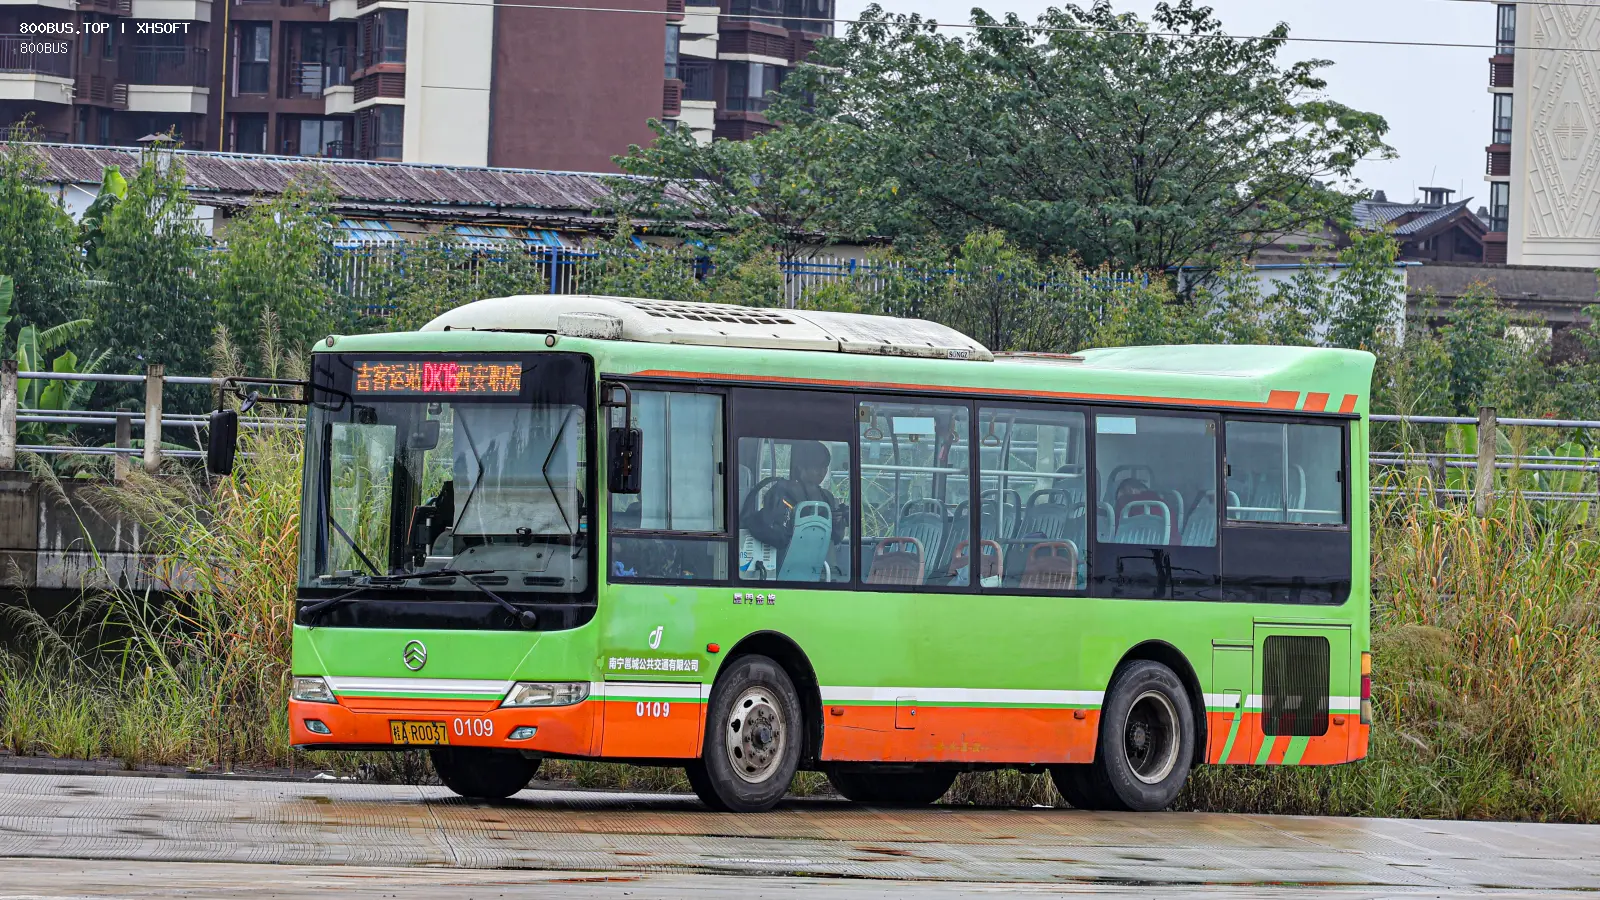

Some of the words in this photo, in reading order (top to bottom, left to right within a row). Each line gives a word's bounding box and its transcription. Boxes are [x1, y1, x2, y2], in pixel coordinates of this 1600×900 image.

[608, 657, 699, 672] 南宁邕城公共交通有限公司
[636, 701, 670, 717] 0109
[453, 718, 493, 736] 0109
